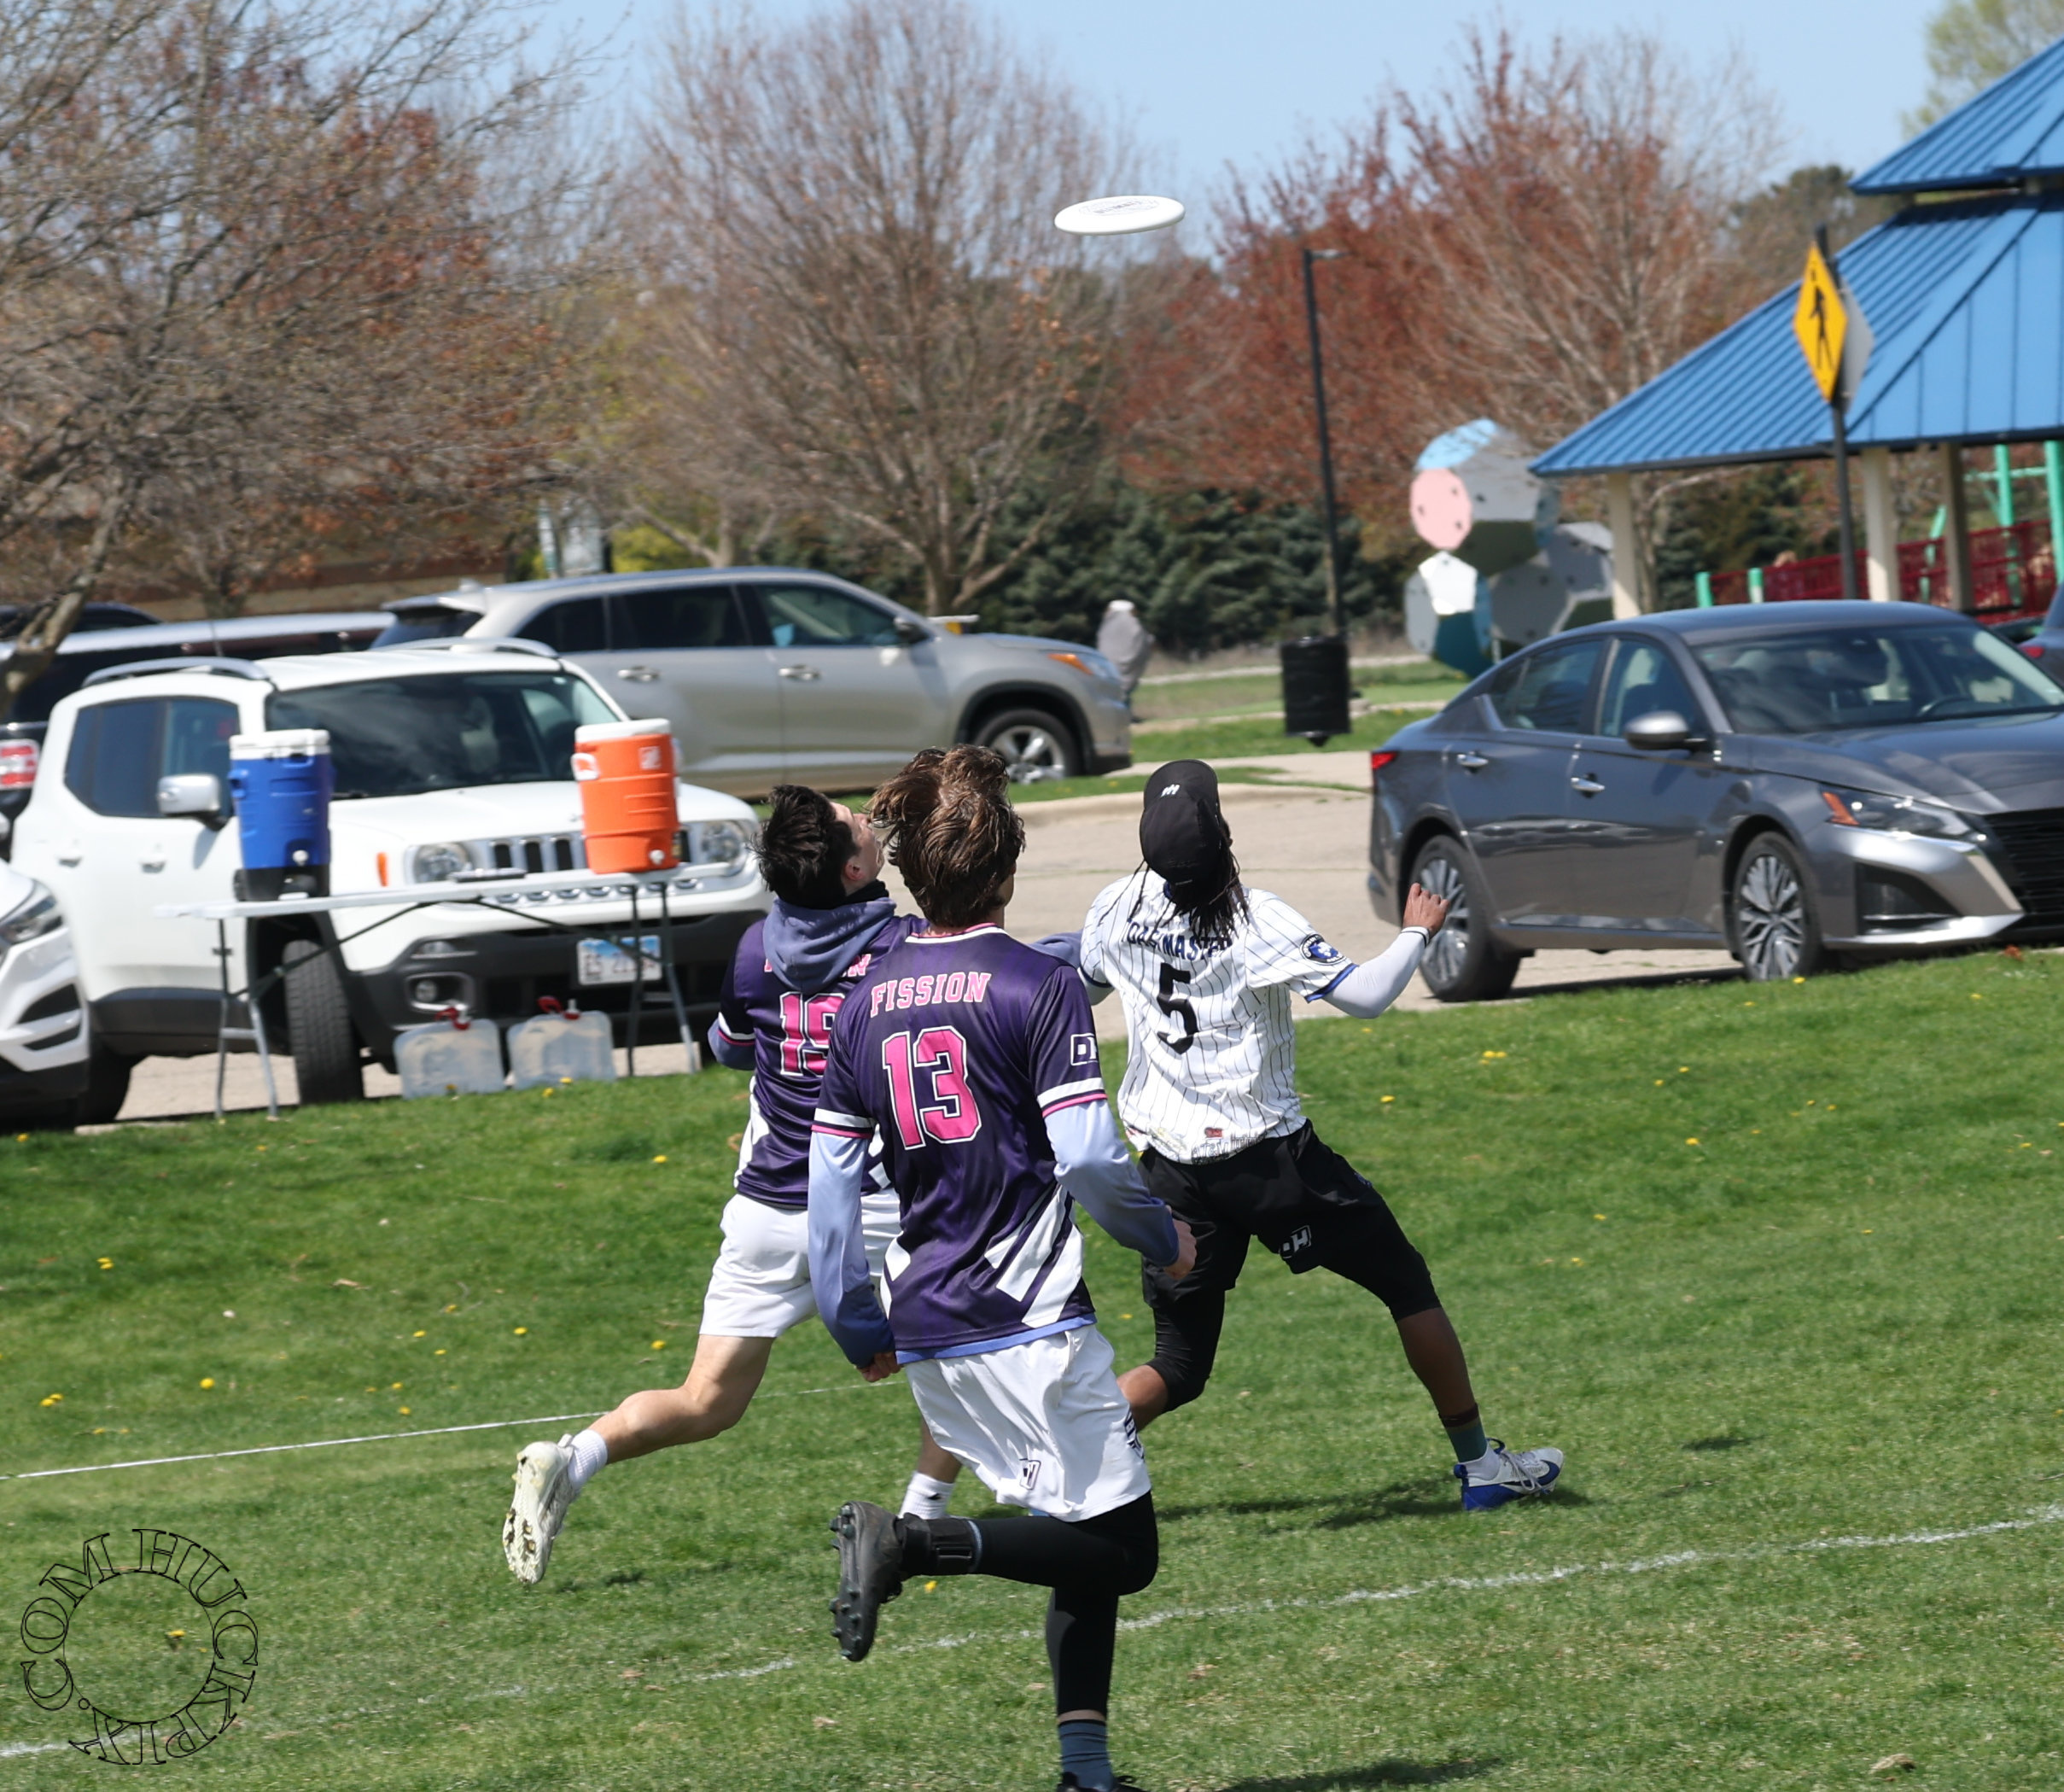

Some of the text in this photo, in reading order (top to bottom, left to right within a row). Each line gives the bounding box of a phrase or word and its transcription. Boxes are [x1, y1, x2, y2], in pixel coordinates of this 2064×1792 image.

[779, 991, 846, 1077] 19
[870, 971, 992, 1018] FISSION
[1157, 962, 1198, 1054] 5
[882, 1025, 982, 1151] 13
